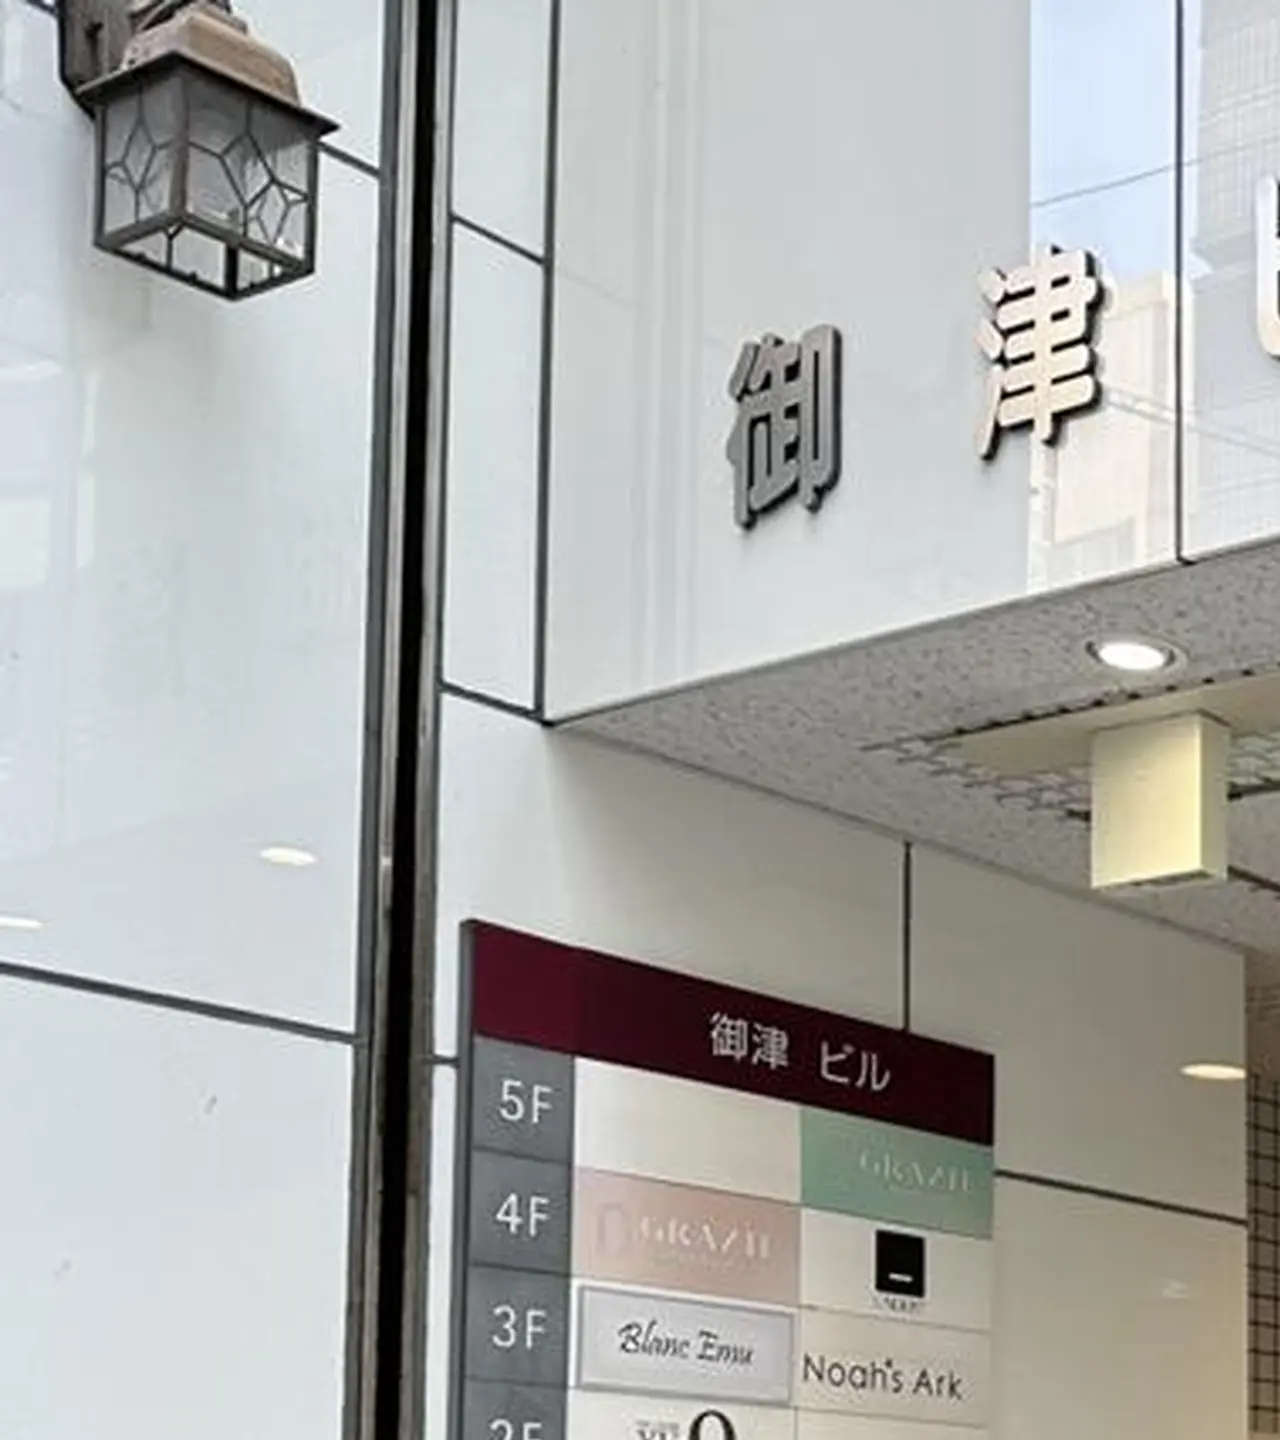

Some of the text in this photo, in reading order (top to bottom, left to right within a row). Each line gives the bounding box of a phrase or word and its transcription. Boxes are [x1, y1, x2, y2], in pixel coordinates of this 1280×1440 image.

[710, 1011, 892, 1092] 御津 ビル
[499, 1078, 553, 1125] 5F
[495, 1191, 551, 1237] 4F
[491, 1303, 547, 1350] 3F
[618, 1319, 755, 1366] Blanc Emu
[802, 1352, 965, 1402] Noah's Ark
